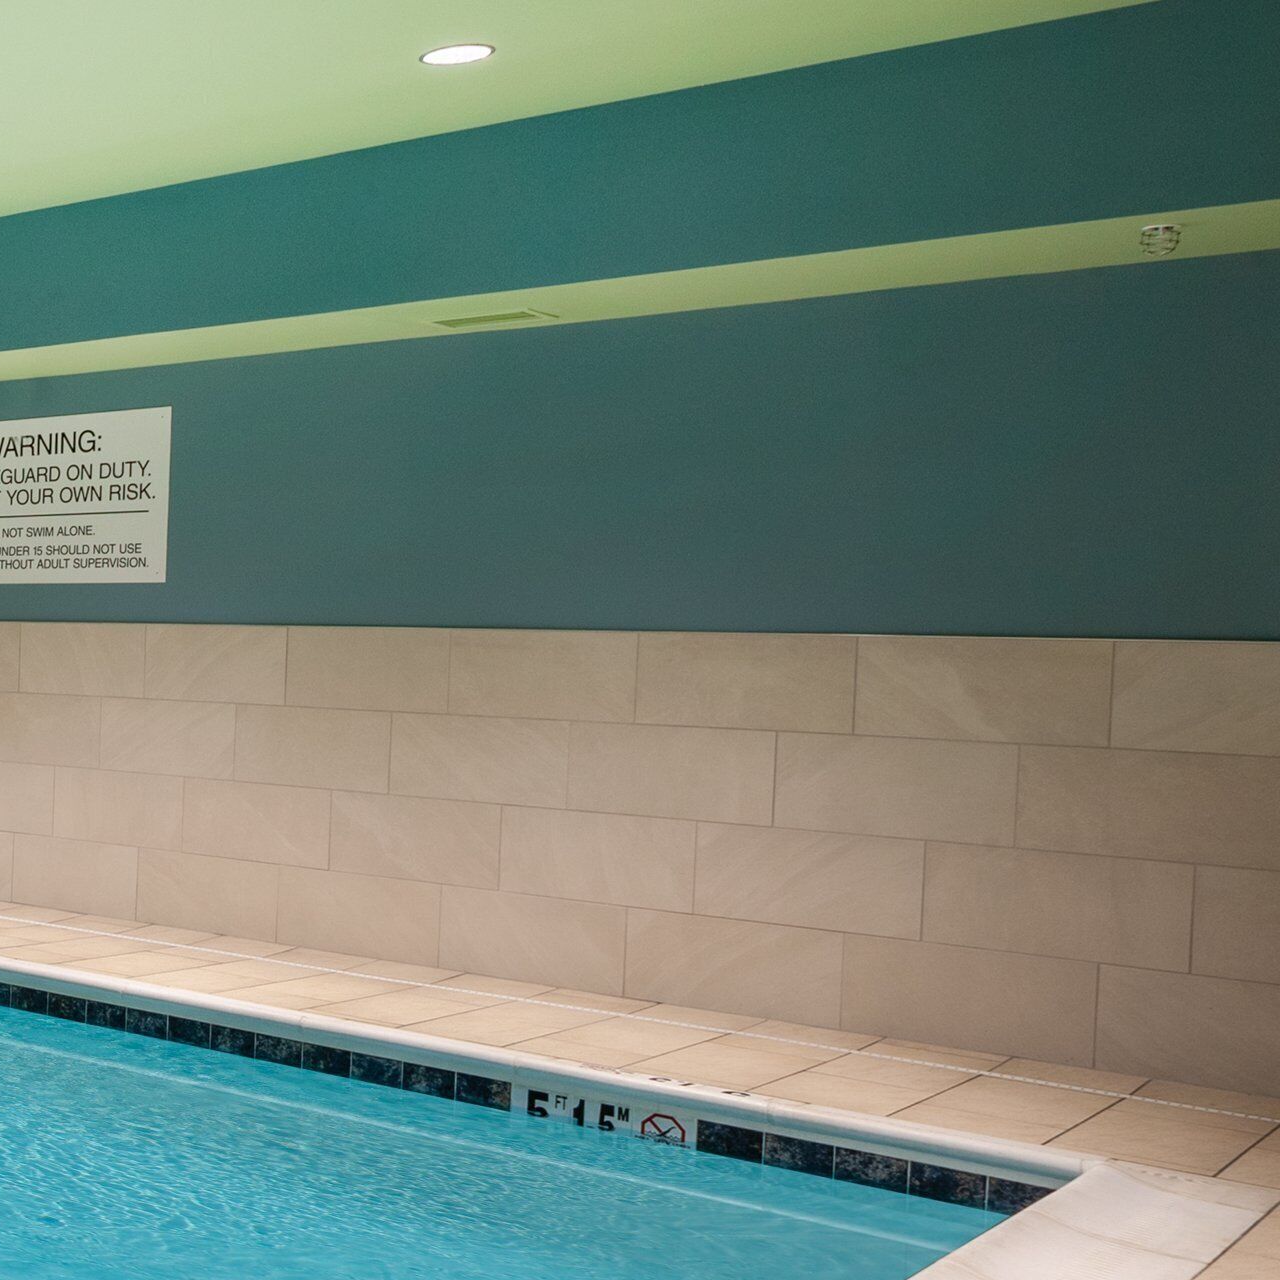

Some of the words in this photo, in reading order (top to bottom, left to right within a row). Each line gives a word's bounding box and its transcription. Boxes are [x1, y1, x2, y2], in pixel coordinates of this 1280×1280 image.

[66, 463, 92, 481] ON
[99, 460, 152, 479] DUTY.
[6, 488, 54, 506] YOUR
[59, 485, 102, 503] OWN
[109, 483, 156, 502] RISK.
[2, 527, 23, 538] NOT
[26, 526, 54, 537] SWIM
[57, 525, 95, 537] ALONE.
[33, 545, 43, 556] 15
[46, 544, 90, 556] SHOULD
[93, 544, 116, 555] NOT
[119, 543, 142, 554] USE
[37, 558, 70, 569] ADULT
[73, 557, 149, 569] SUPERVISION.
[527, 1089, 549, 1118] 5
[555, 1095, 567, 1111] FT
[618, 1106, 630, 1122] M
